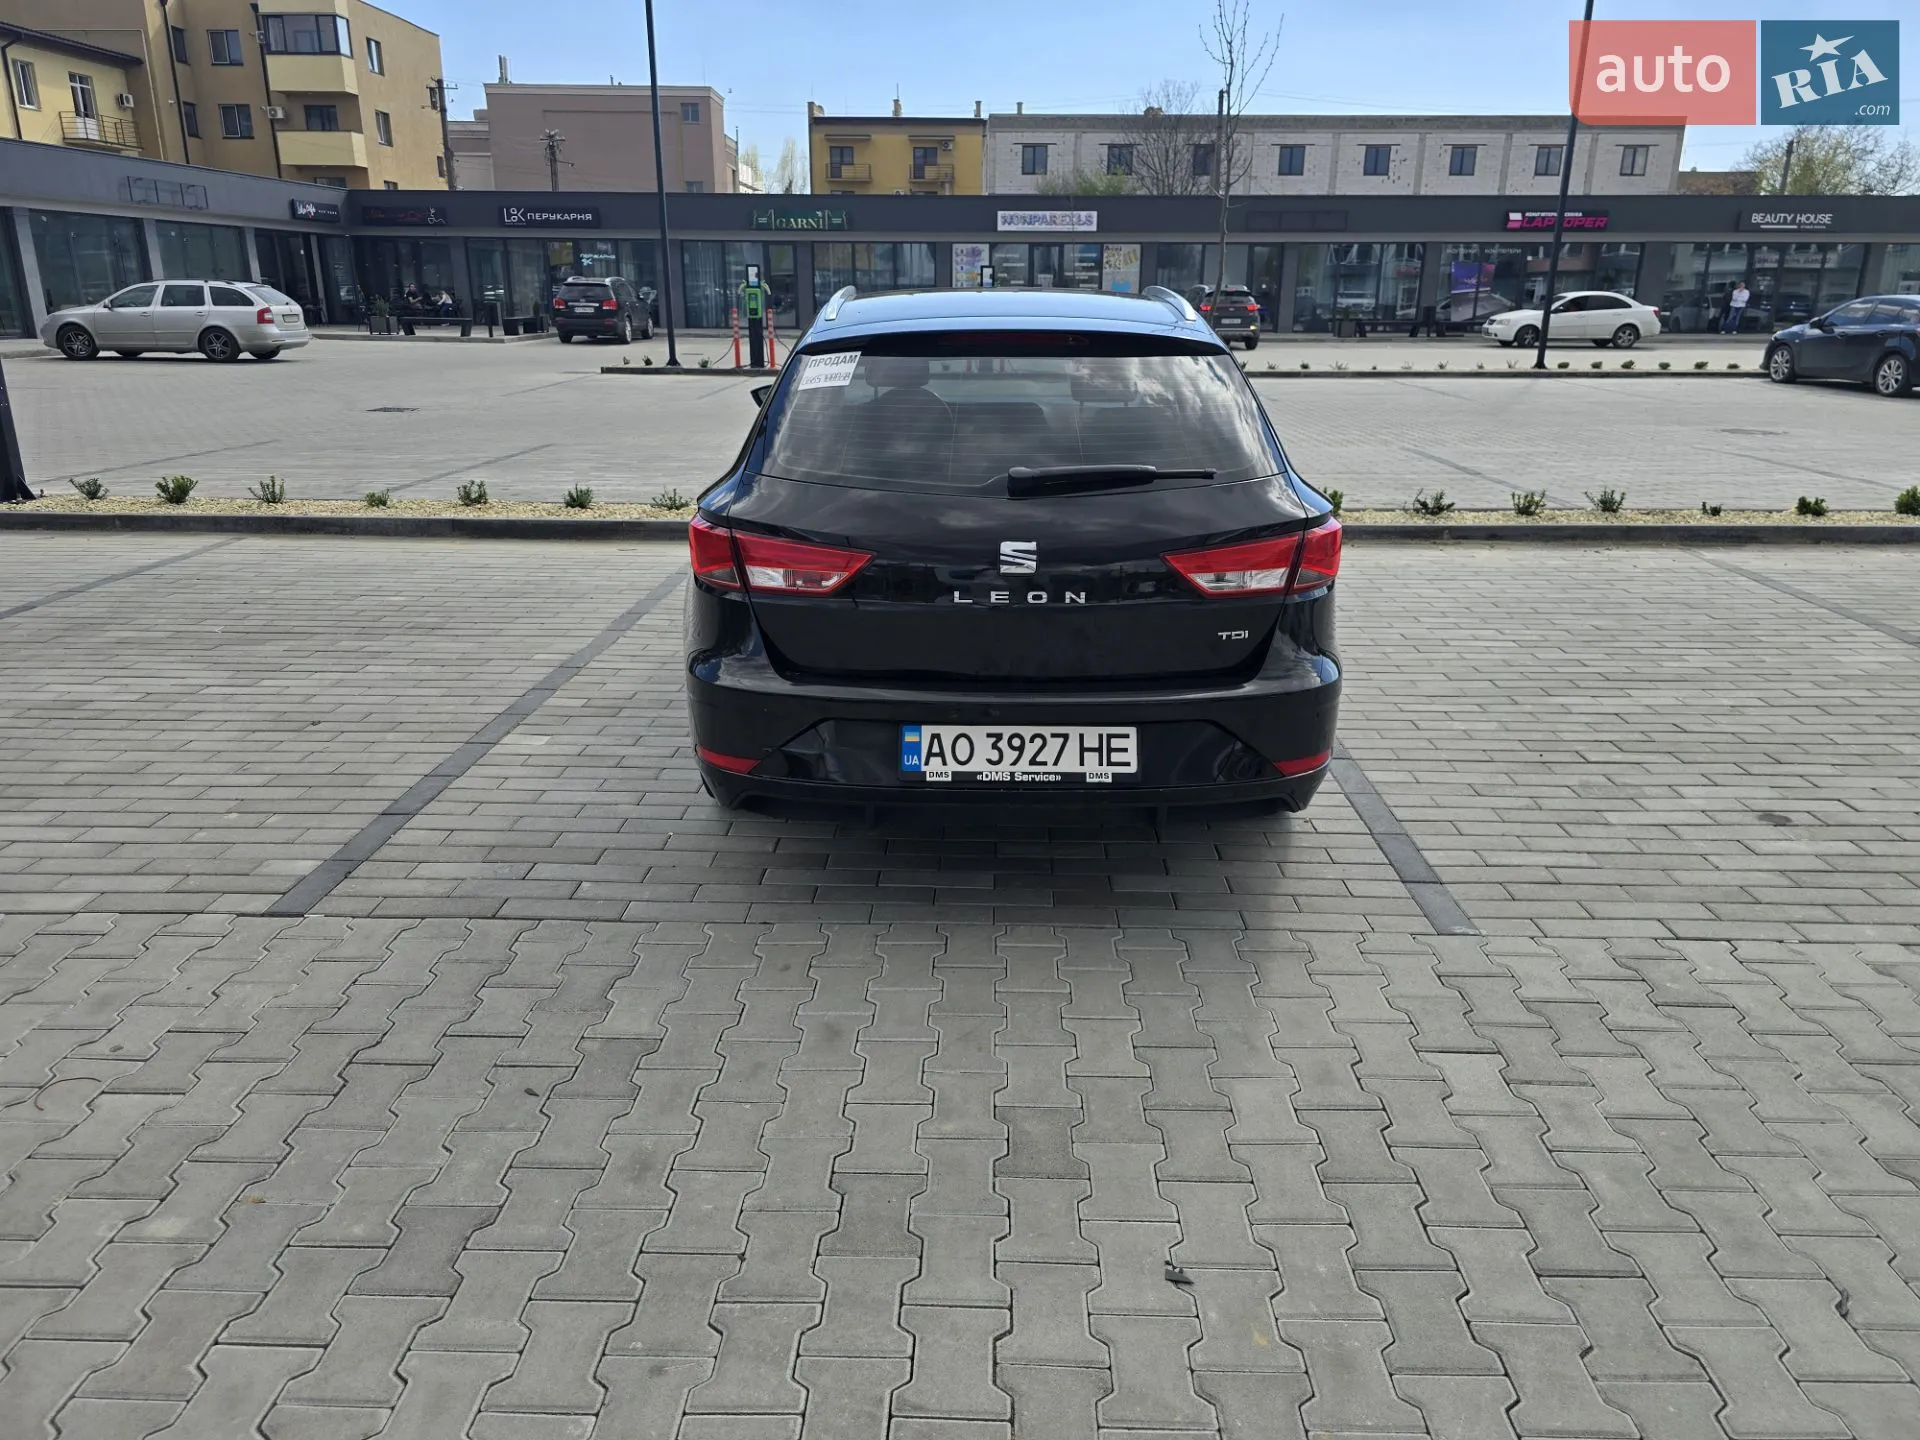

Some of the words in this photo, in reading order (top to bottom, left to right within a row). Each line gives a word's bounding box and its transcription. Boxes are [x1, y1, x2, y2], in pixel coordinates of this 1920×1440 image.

[527, 212, 593, 221] ПЕРУКАРНЯ
[1751, 212, 1795, 224] BEAUTY
[1796, 213, 1834, 225] HOUSE
[1522, 217, 1607, 228] LAPOPER
[808, 354, 858, 368] ПРОДАМ
[953, 590, 1087, 604] LEON
[1218, 630, 1249, 640] TDI
[985, 732, 1070, 767] 3927
[1079, 732, 1132, 767] HE
[904, 755, 920, 766] UA
[928, 771, 950, 780] DMS
[1088, 772, 1110, 780] DMS
